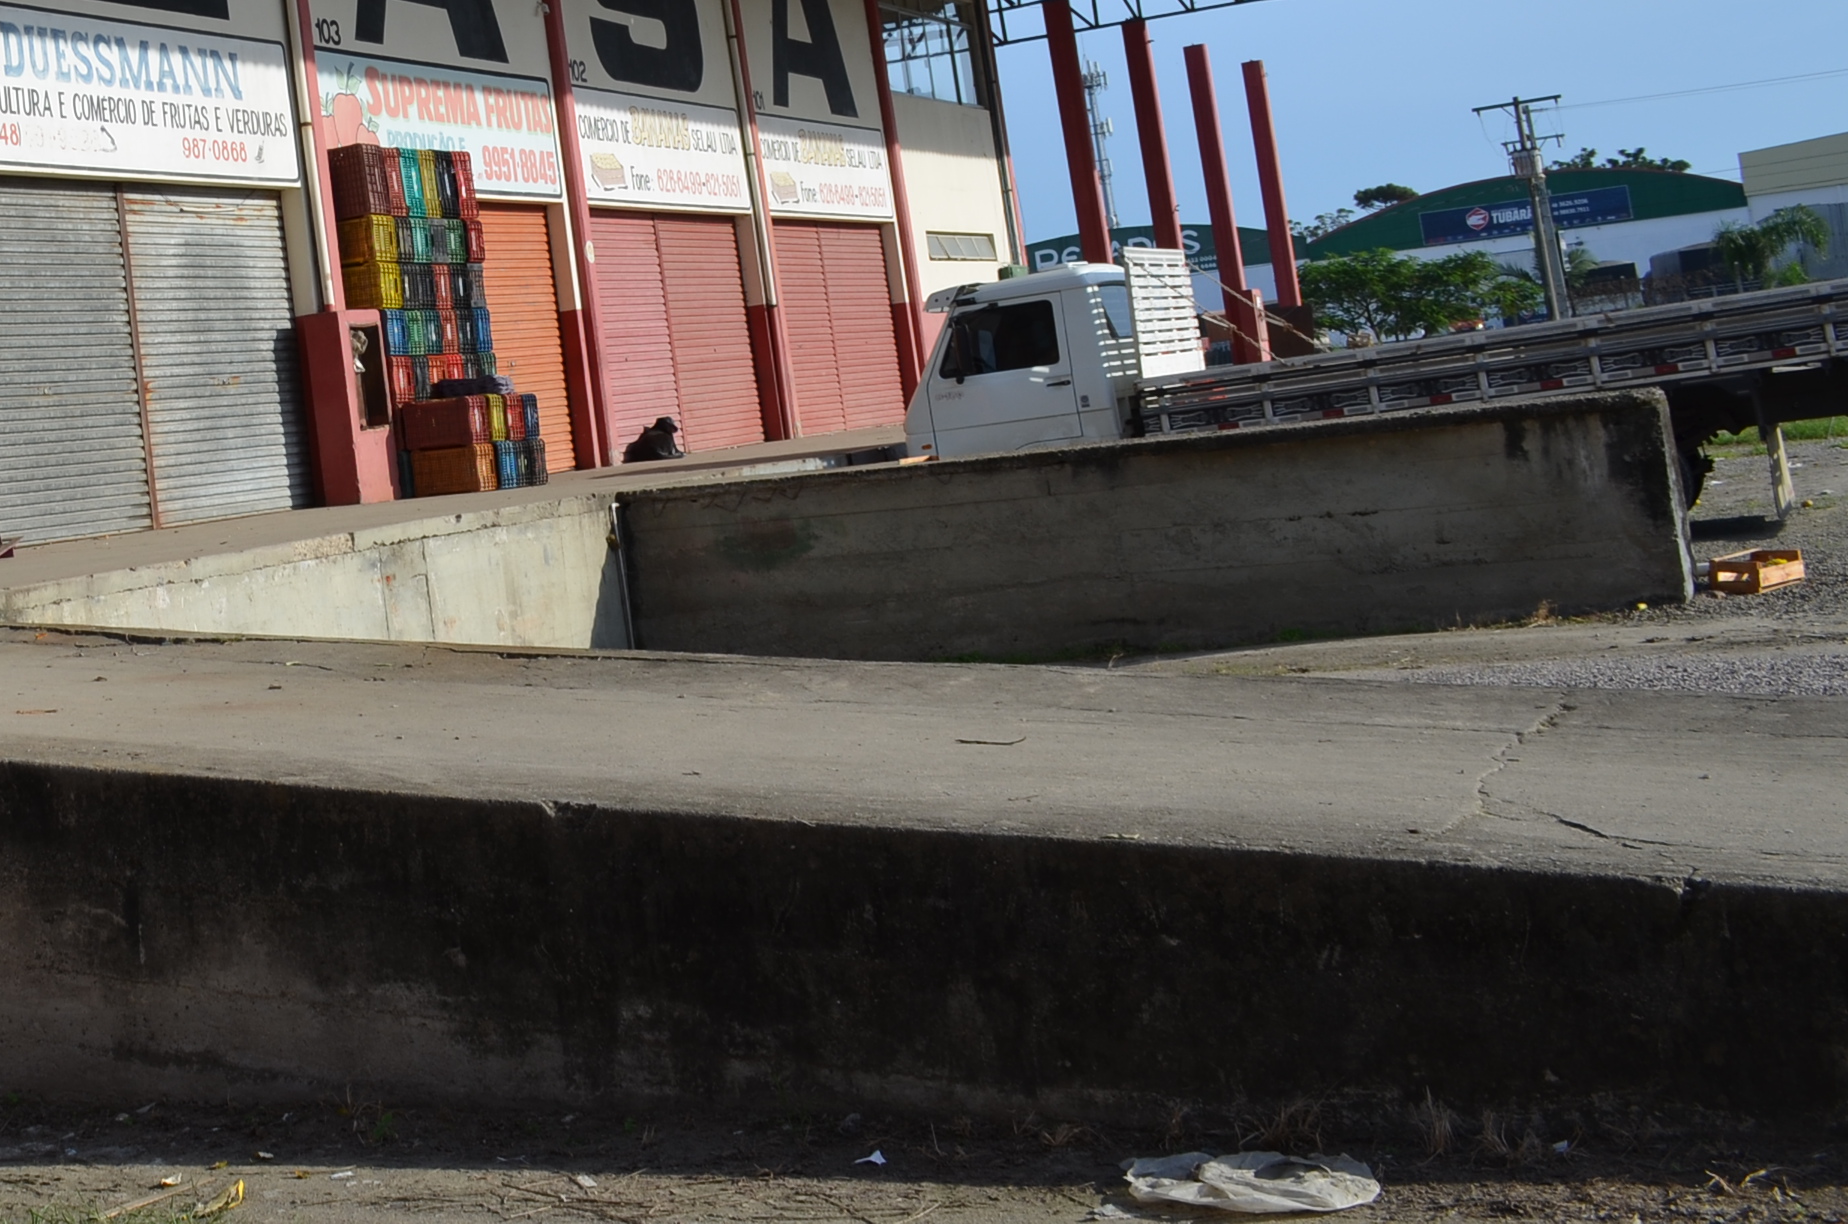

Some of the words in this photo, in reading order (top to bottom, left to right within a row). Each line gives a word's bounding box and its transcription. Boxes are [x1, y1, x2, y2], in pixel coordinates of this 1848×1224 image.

[315, 17, 342, 46] 103
[0, 20, 243, 101] DUESSMANN
[568, 58, 588, 83] 102
[58, 91, 68, 119] E
[141, 99, 158, 127] DE
[162, 101, 210, 132] FRUTAS
[214, 106, 223, 133] E
[225, 107, 288, 138] VERDURAS
[364, 65, 483, 127] SUPREMA
[482, 84, 553, 135] FRUTAS
[620, 120, 632, 145] DE
[628, 105, 692, 151] BANANAS
[1491, 206, 1533, 224] TUBARÃ
